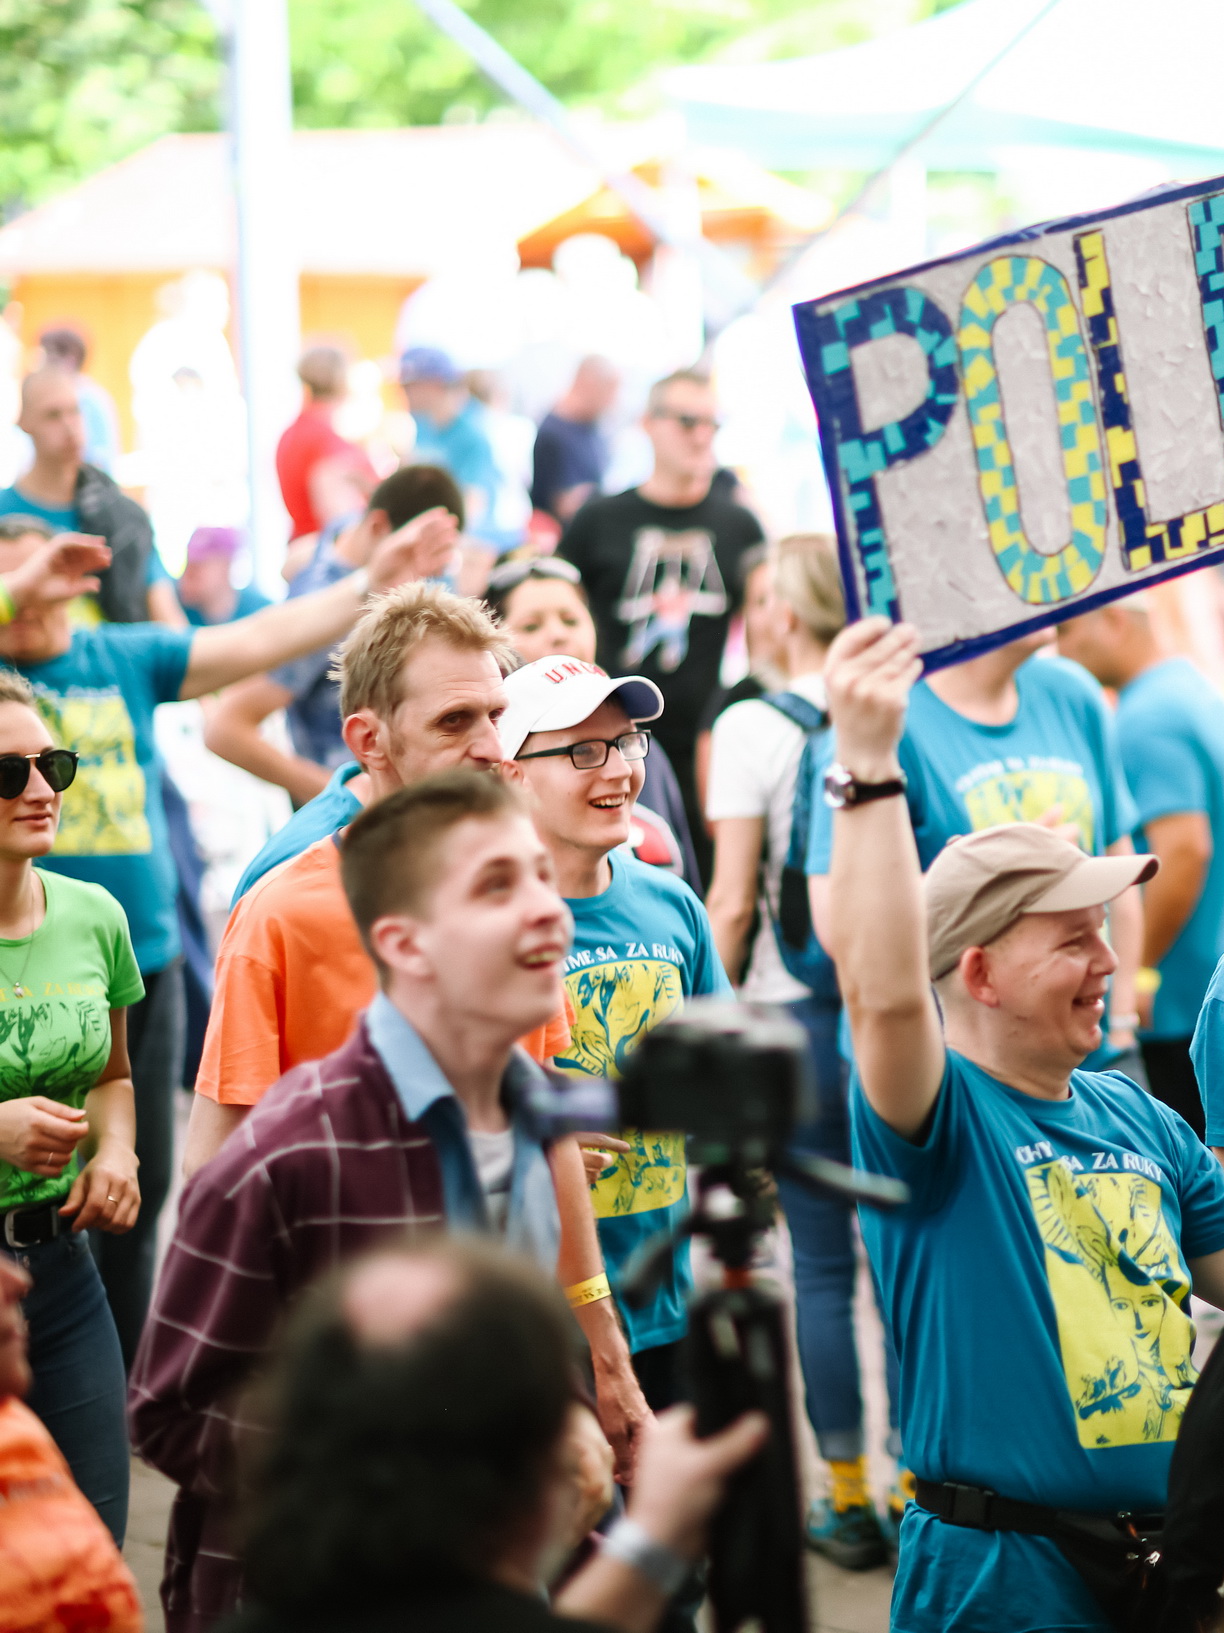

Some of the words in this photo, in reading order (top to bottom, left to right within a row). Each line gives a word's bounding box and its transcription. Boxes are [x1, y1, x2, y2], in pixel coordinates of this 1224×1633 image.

[595, 945, 618, 962] SA
[625, 942, 649, 958] ZA
[1092, 1152, 1119, 1170] ZA
[1123, 1152, 1162, 1183] RUKY
